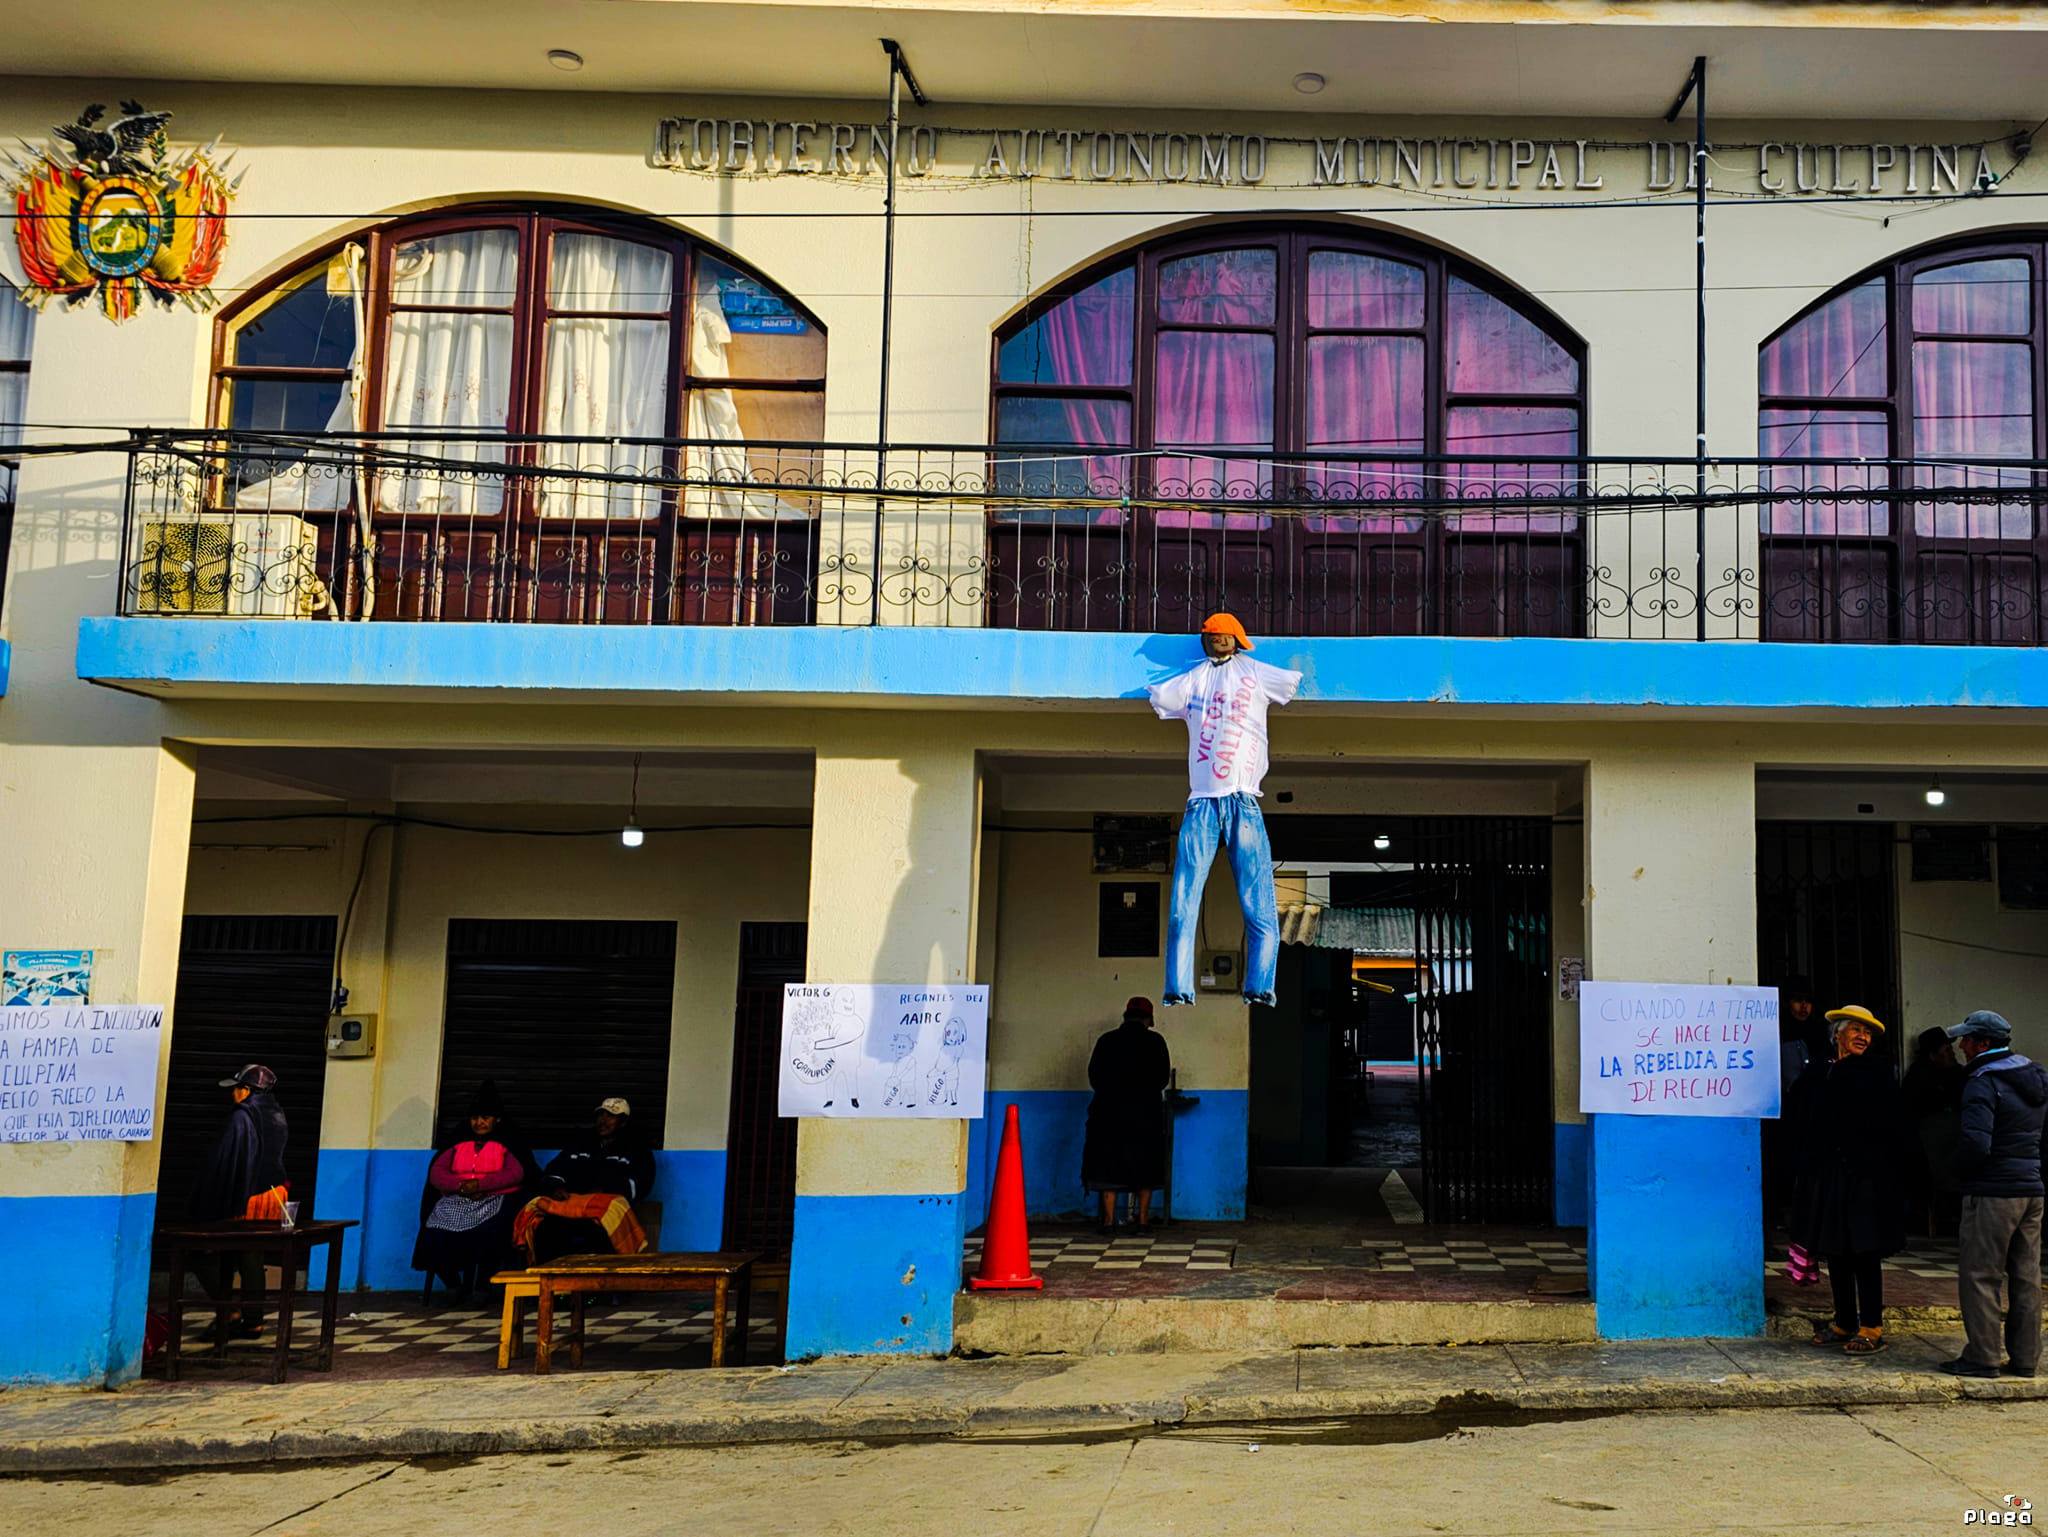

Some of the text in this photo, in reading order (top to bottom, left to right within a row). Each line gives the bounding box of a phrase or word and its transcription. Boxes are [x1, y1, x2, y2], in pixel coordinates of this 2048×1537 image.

[653, 118, 1999, 194] GOBIERNO AUTONOMO MUNICIPAL DE CULPINA
[1197, 690, 1229, 764] VICTOR
[1212, 675, 1257, 780] GALLARDO
[787, 986, 832, 998] VICTOR G
[64, 1010, 85, 1029] LA
[1600, 999, 1686, 1021] CUANDO
[1697, 999, 1716, 1020] LA
[22, 1036, 79, 1058] PAMPA
[92, 1037, 116, 1054] DE
[1635, 1024, 1752, 1048] SE HACE LEY
[3, 1062, 76, 1086] CULPINA
[792, 1057, 836, 1078] CORRUPCION
[1600, 1050, 1754, 1078] LA REBELDIA ES
[106, 1085, 125, 1102] LA
[4, 1114, 29, 1131] QUE
[7, 1130, 48, 1142] SECTOR
[78, 1128, 115, 1140] VICTOR
